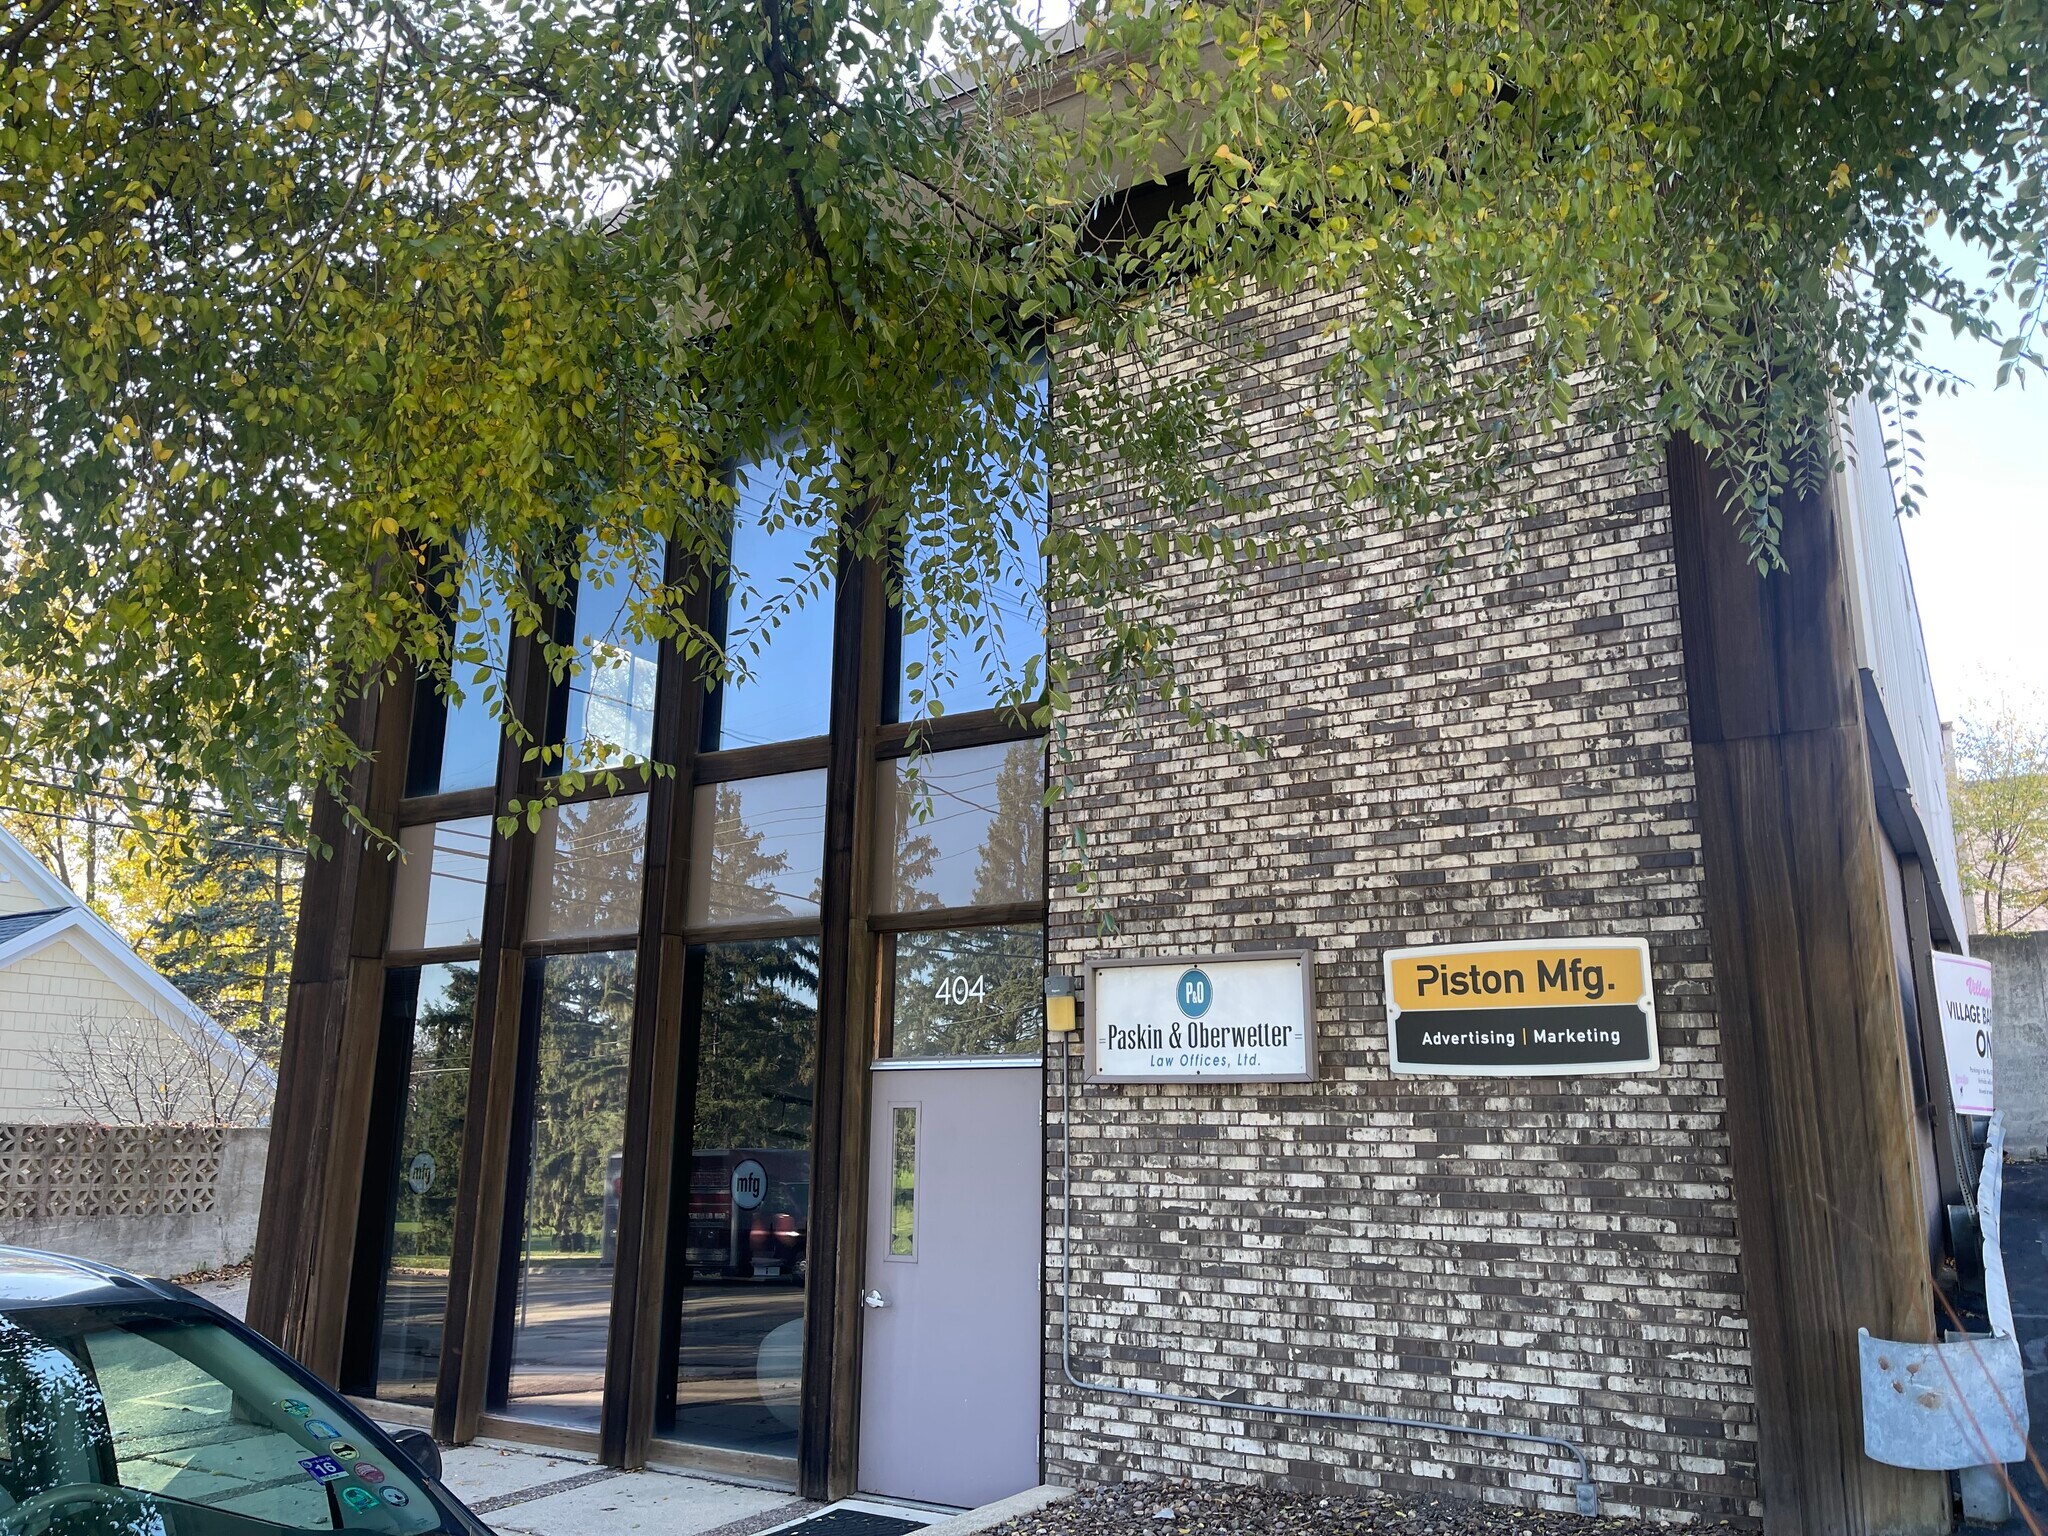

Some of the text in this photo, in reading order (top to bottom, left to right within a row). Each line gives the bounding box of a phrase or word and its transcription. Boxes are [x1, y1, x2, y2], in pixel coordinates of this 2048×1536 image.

[935, 974, 986, 1006] 404
[1416, 958, 1615, 1000] Piston Mfg.
[1966, 976, 1991, 1003] Villag
[1185, 981, 1204, 1004] P&O
[1946, 1000, 1981, 1024] VILLAGE
[1108, 1021, 1293, 1050] Paskin & Oberwetter
[1422, 1028, 1621, 1047] Advertising Marketing
[1150, 1053, 1261, 1068] Law Offices, Ltd.
[412, 1163, 431, 1185] mfg
[736, 1172, 760, 1198] mfg
[315, 1462, 337, 1474] 16
